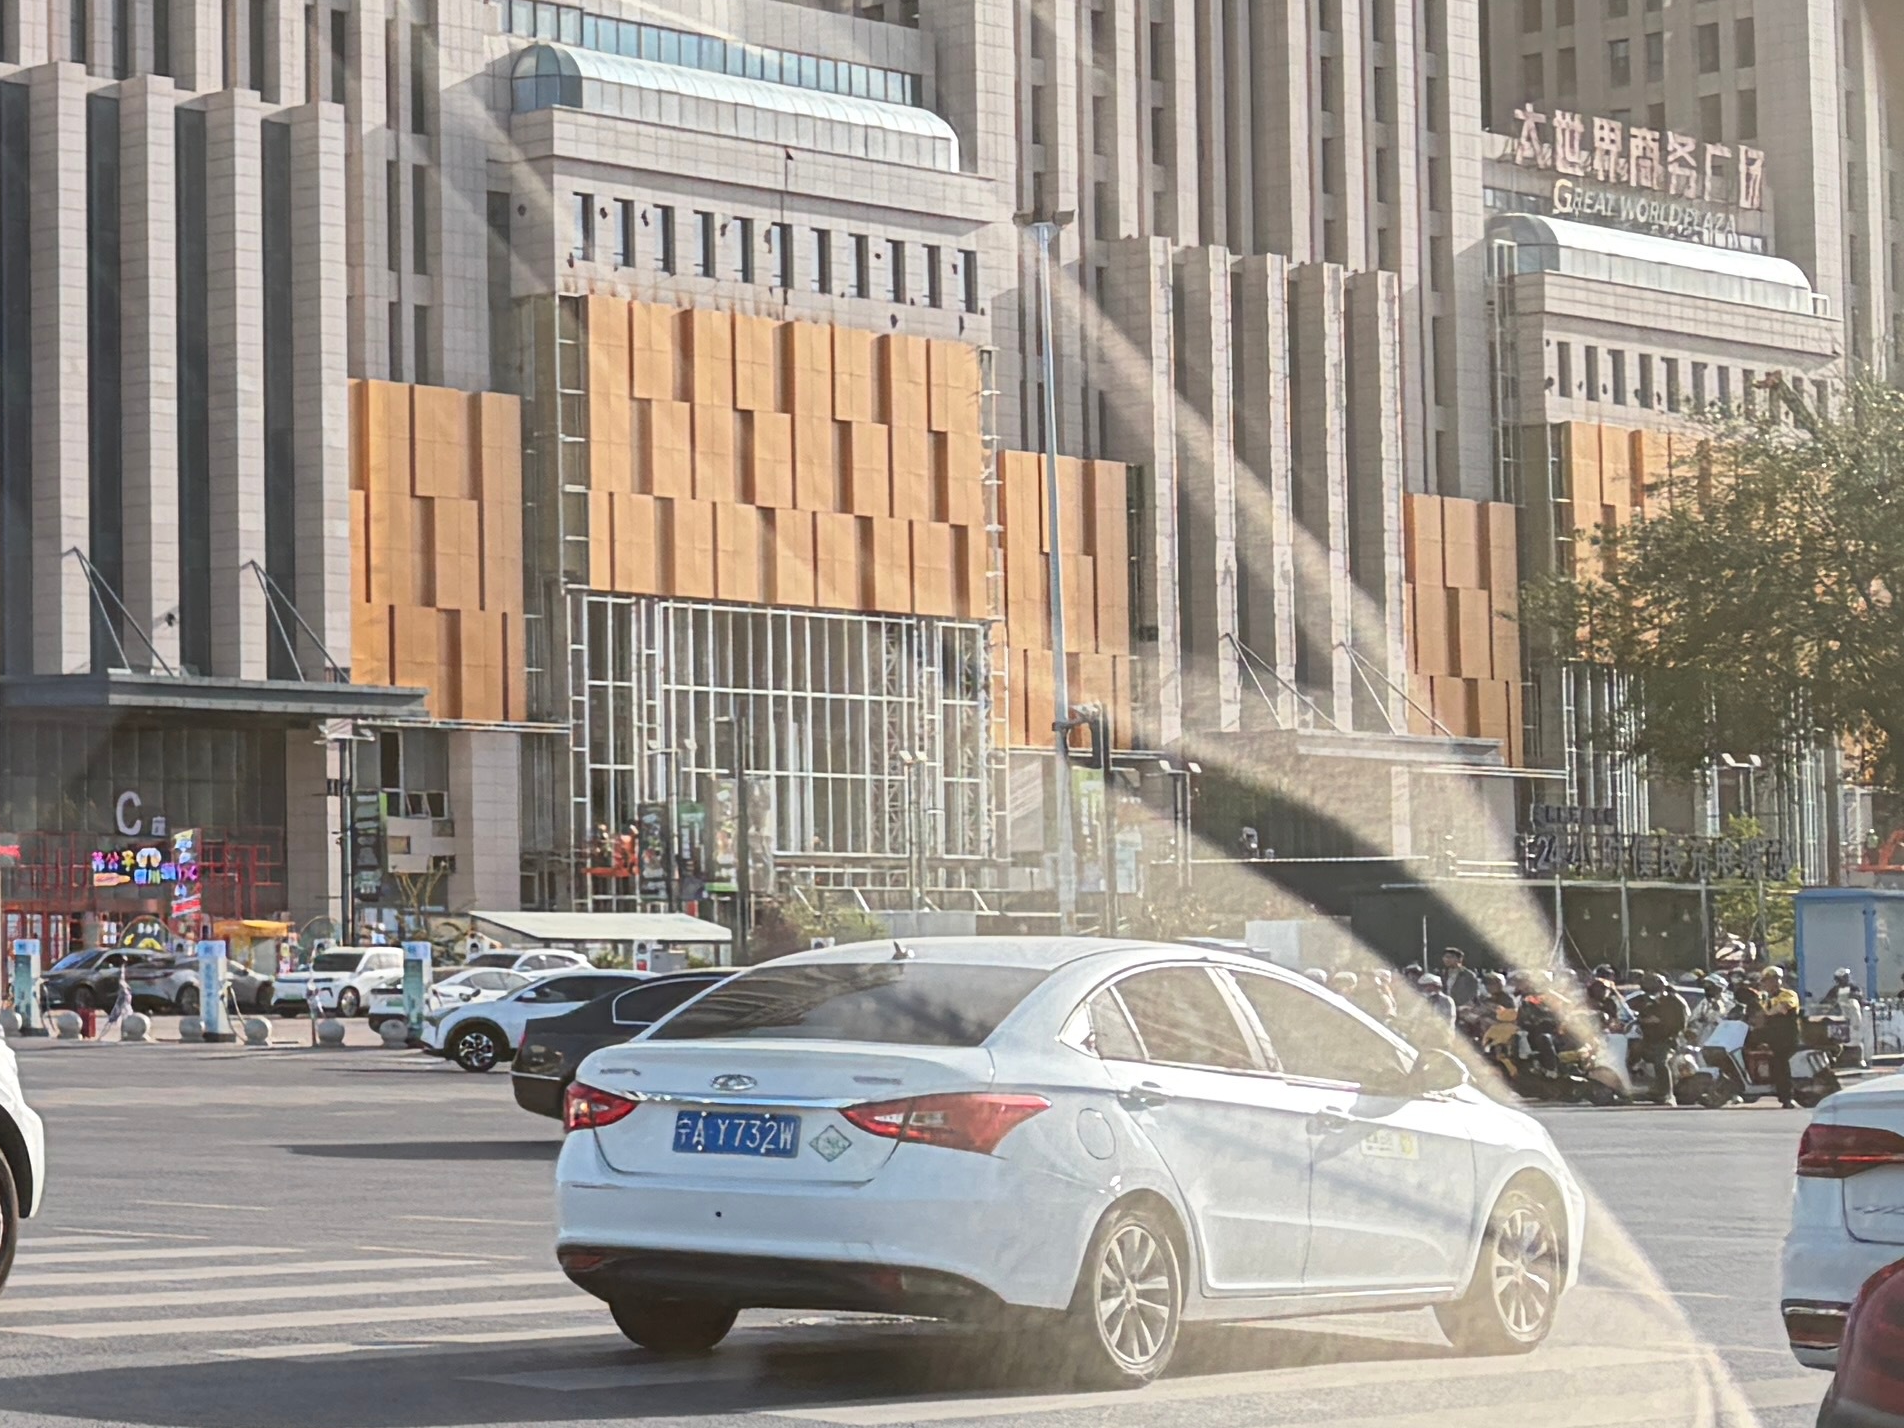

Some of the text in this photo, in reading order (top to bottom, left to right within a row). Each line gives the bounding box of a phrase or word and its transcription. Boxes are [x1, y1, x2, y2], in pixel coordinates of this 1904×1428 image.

[1514, 103, 1765, 210] 大世界商务广场
[1553, 178, 1618, 217] GREAT
